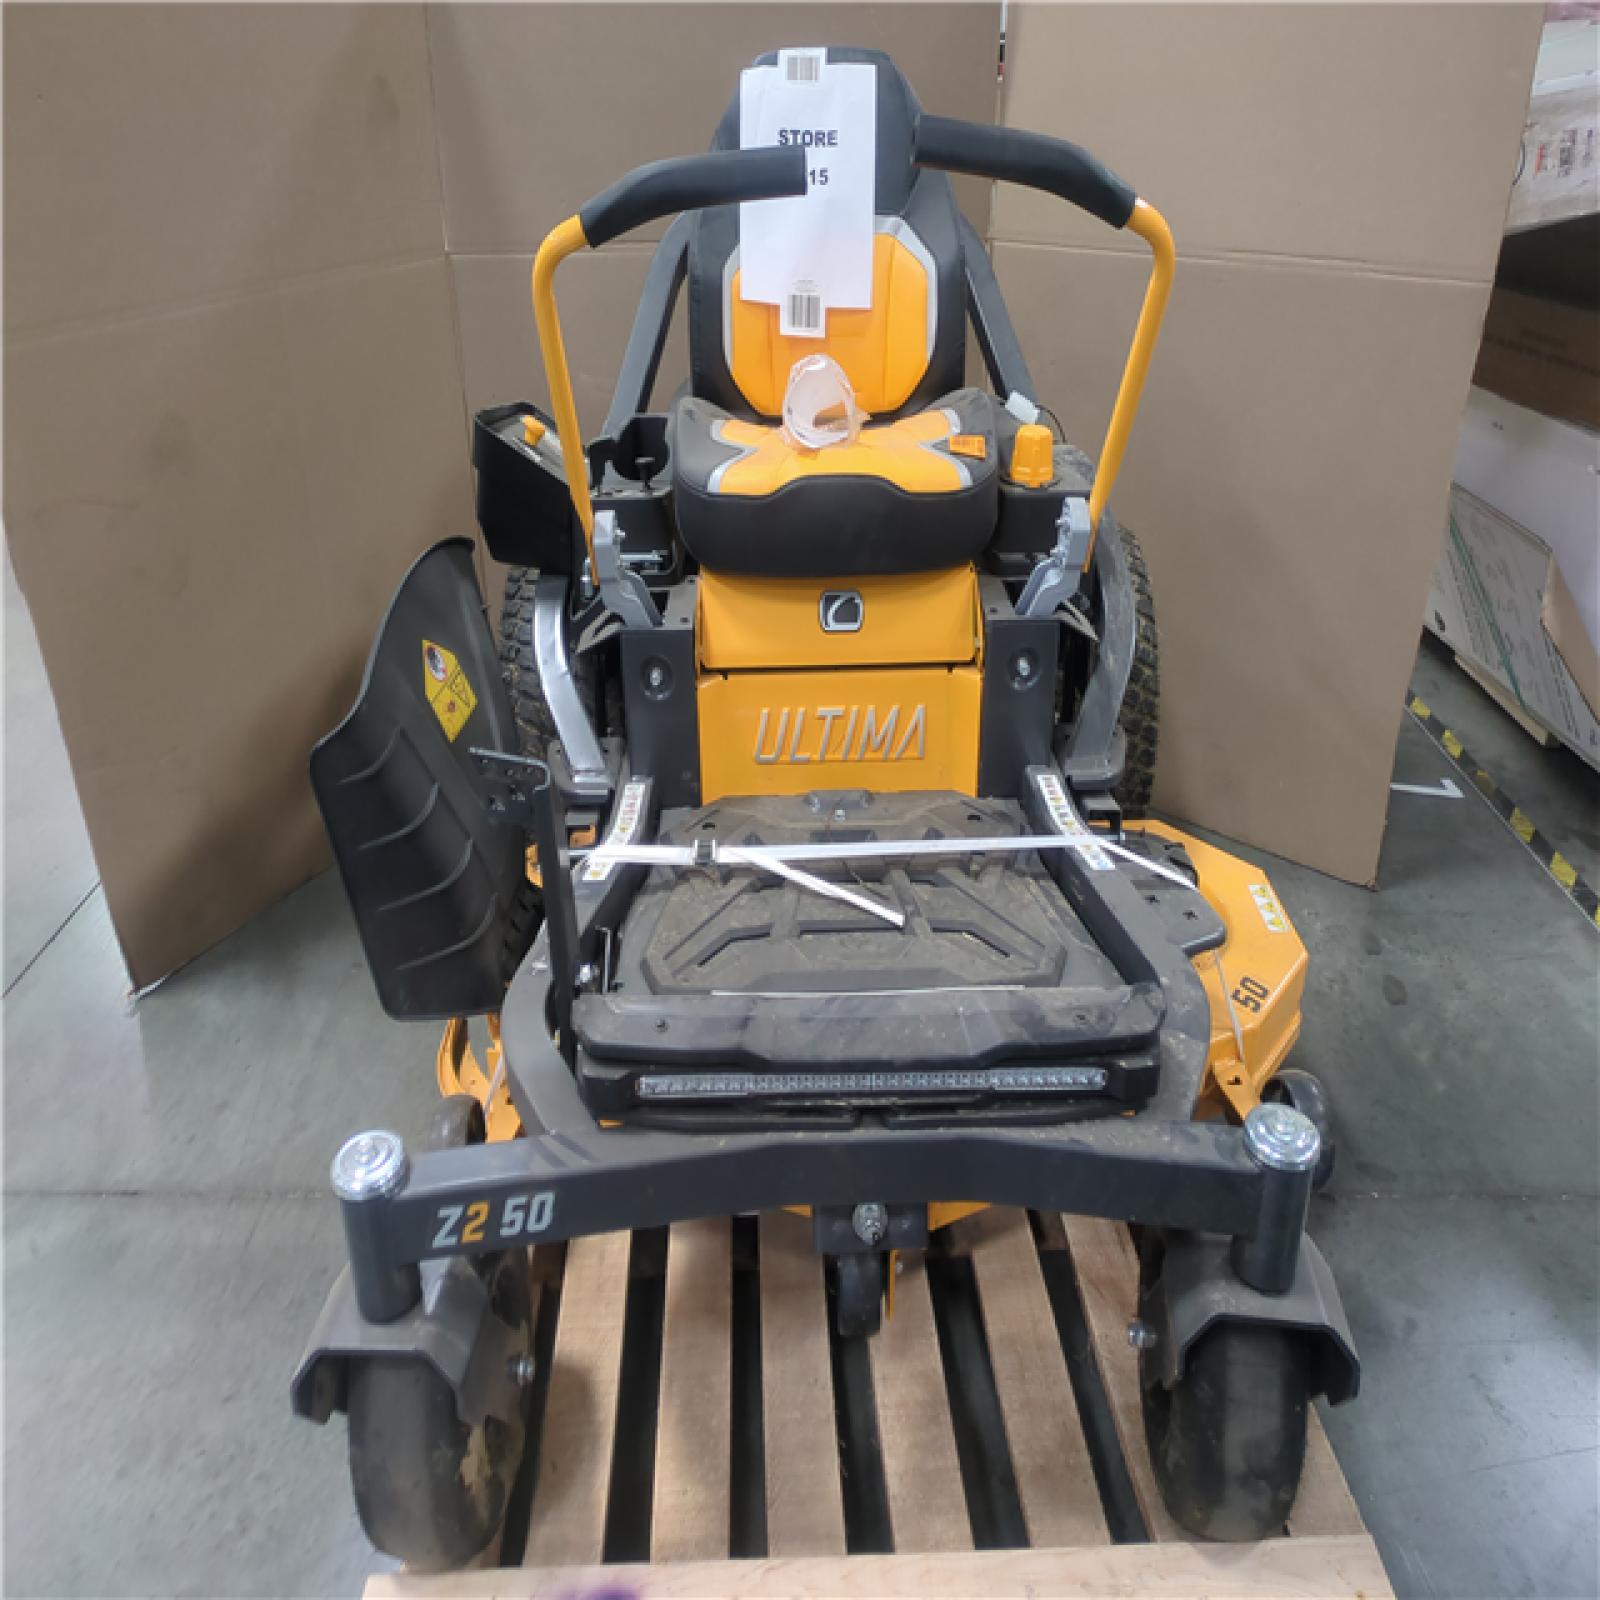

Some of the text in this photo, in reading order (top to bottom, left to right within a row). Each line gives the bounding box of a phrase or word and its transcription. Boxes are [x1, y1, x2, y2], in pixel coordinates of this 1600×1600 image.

[777, 129, 838, 147] STORE
[809, 168, 828, 186] 15
[754, 704, 925, 764] ULTIMA
[1231, 976, 1269, 1013] 50
[432, 1191, 556, 1249] Z2 50
